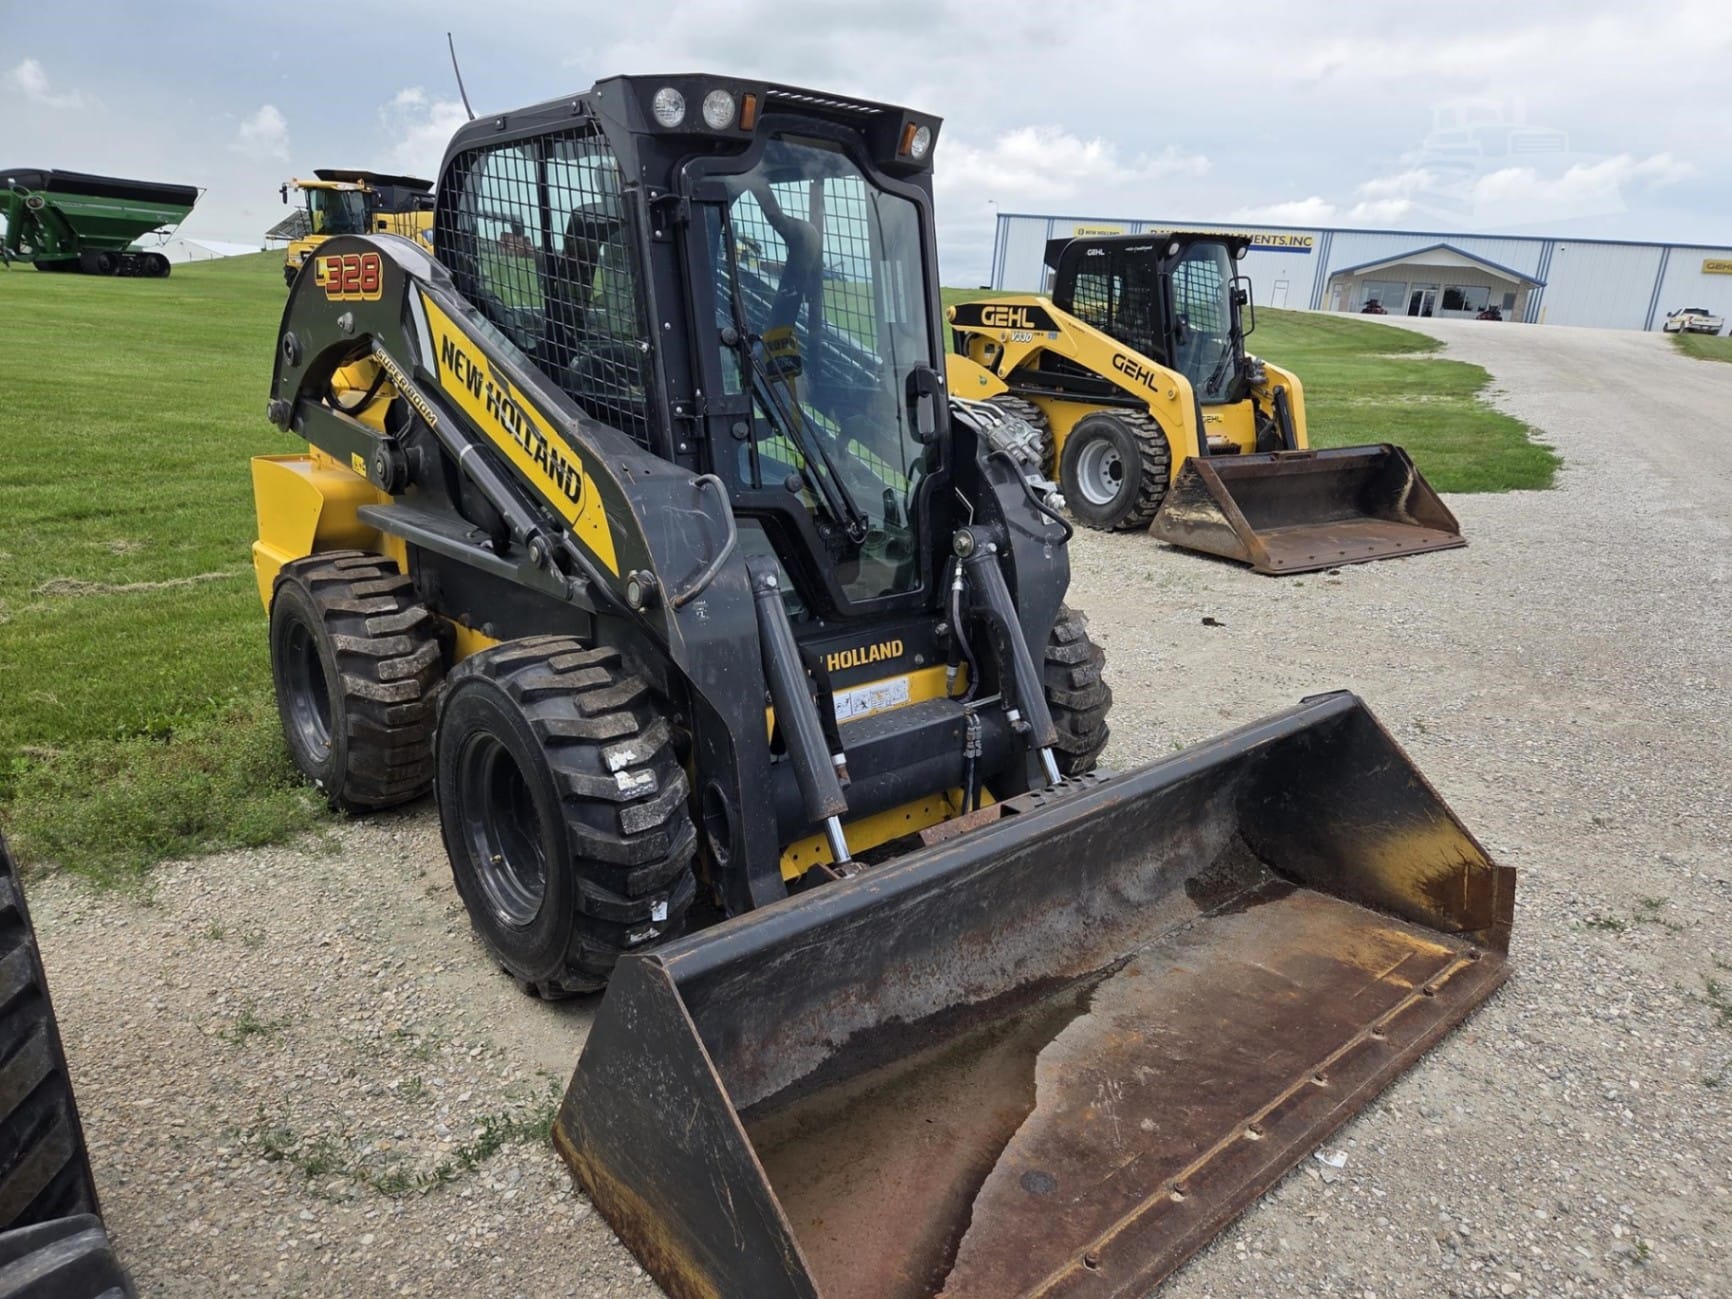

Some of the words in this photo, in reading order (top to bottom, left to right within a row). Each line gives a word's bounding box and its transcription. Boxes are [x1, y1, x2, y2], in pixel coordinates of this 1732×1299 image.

[1086, 248, 1106, 256] GEHL
[314, 252, 384, 301] L328
[981, 306, 1035, 329] GEHL
[1112, 353, 1159, 393] GEHL
[441, 334, 484, 400] NEW
[486, 380, 582, 505] HOLLAND
[826, 640, 904, 672] HOLLAND
